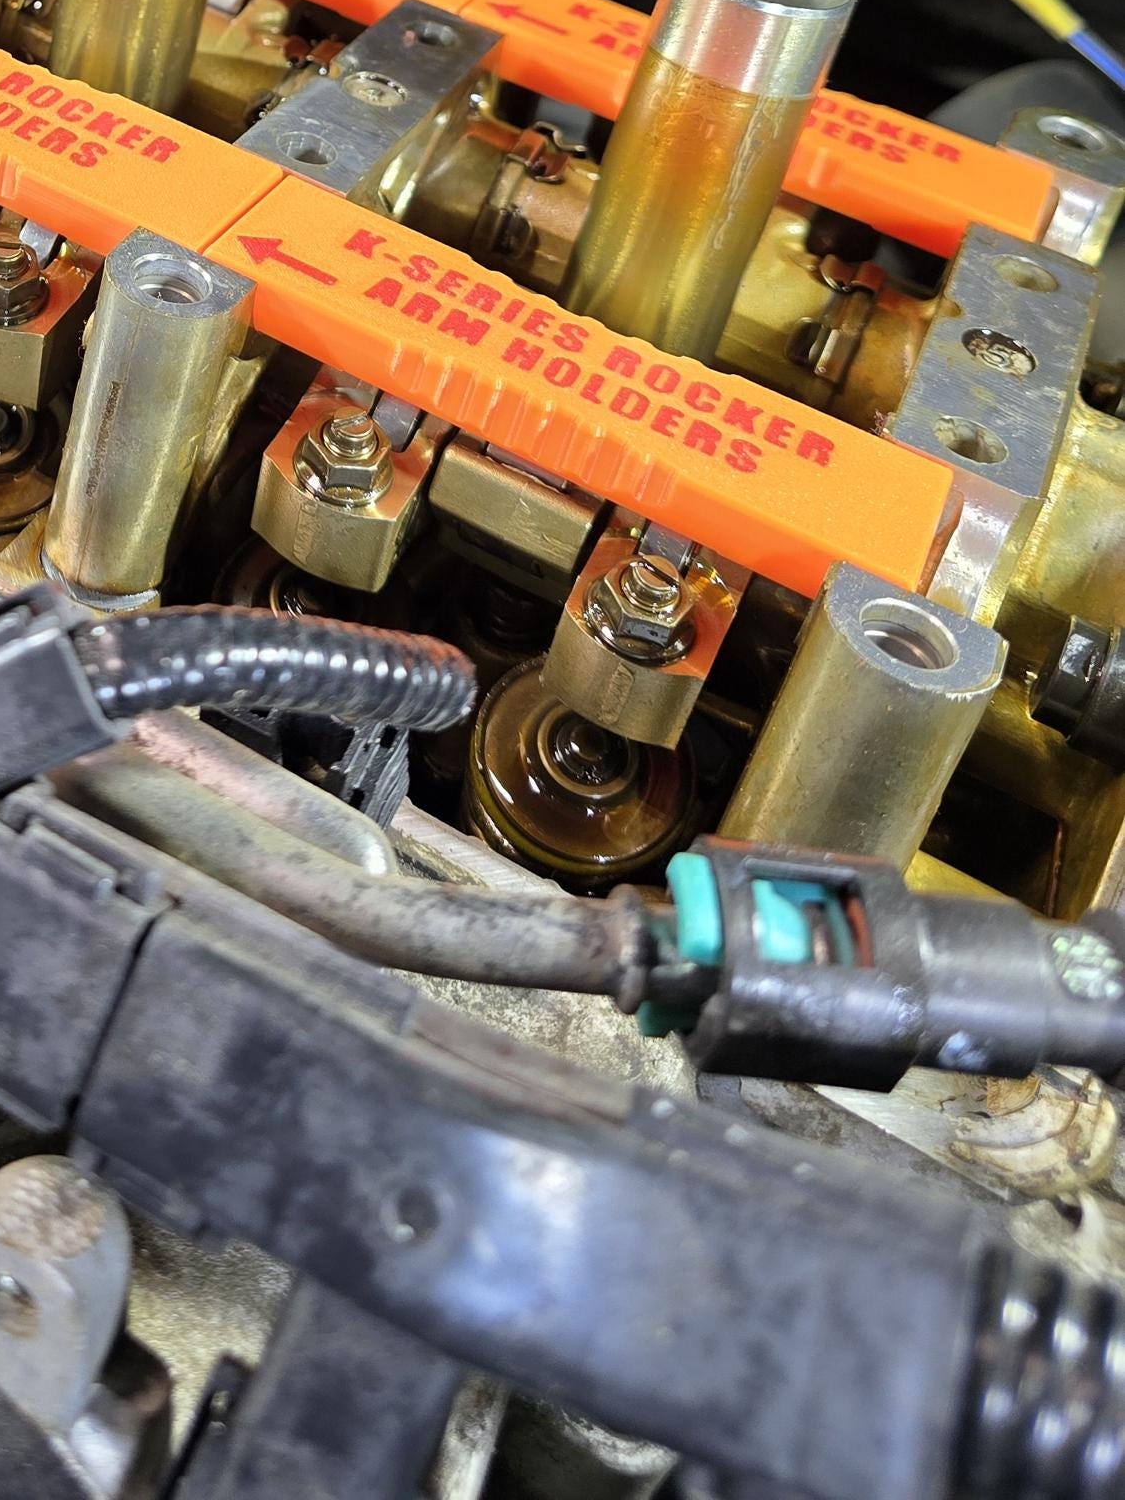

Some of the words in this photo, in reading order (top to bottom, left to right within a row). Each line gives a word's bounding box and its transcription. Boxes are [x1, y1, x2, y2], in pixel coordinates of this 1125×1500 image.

[814, 96, 963, 164] OCKER
[343, 228, 591, 354] K-SERIES
[608, 344, 837, 469] ROCKER
[363, 276, 492, 349] ARM
[501, 339, 764, 475] HOLDERS
